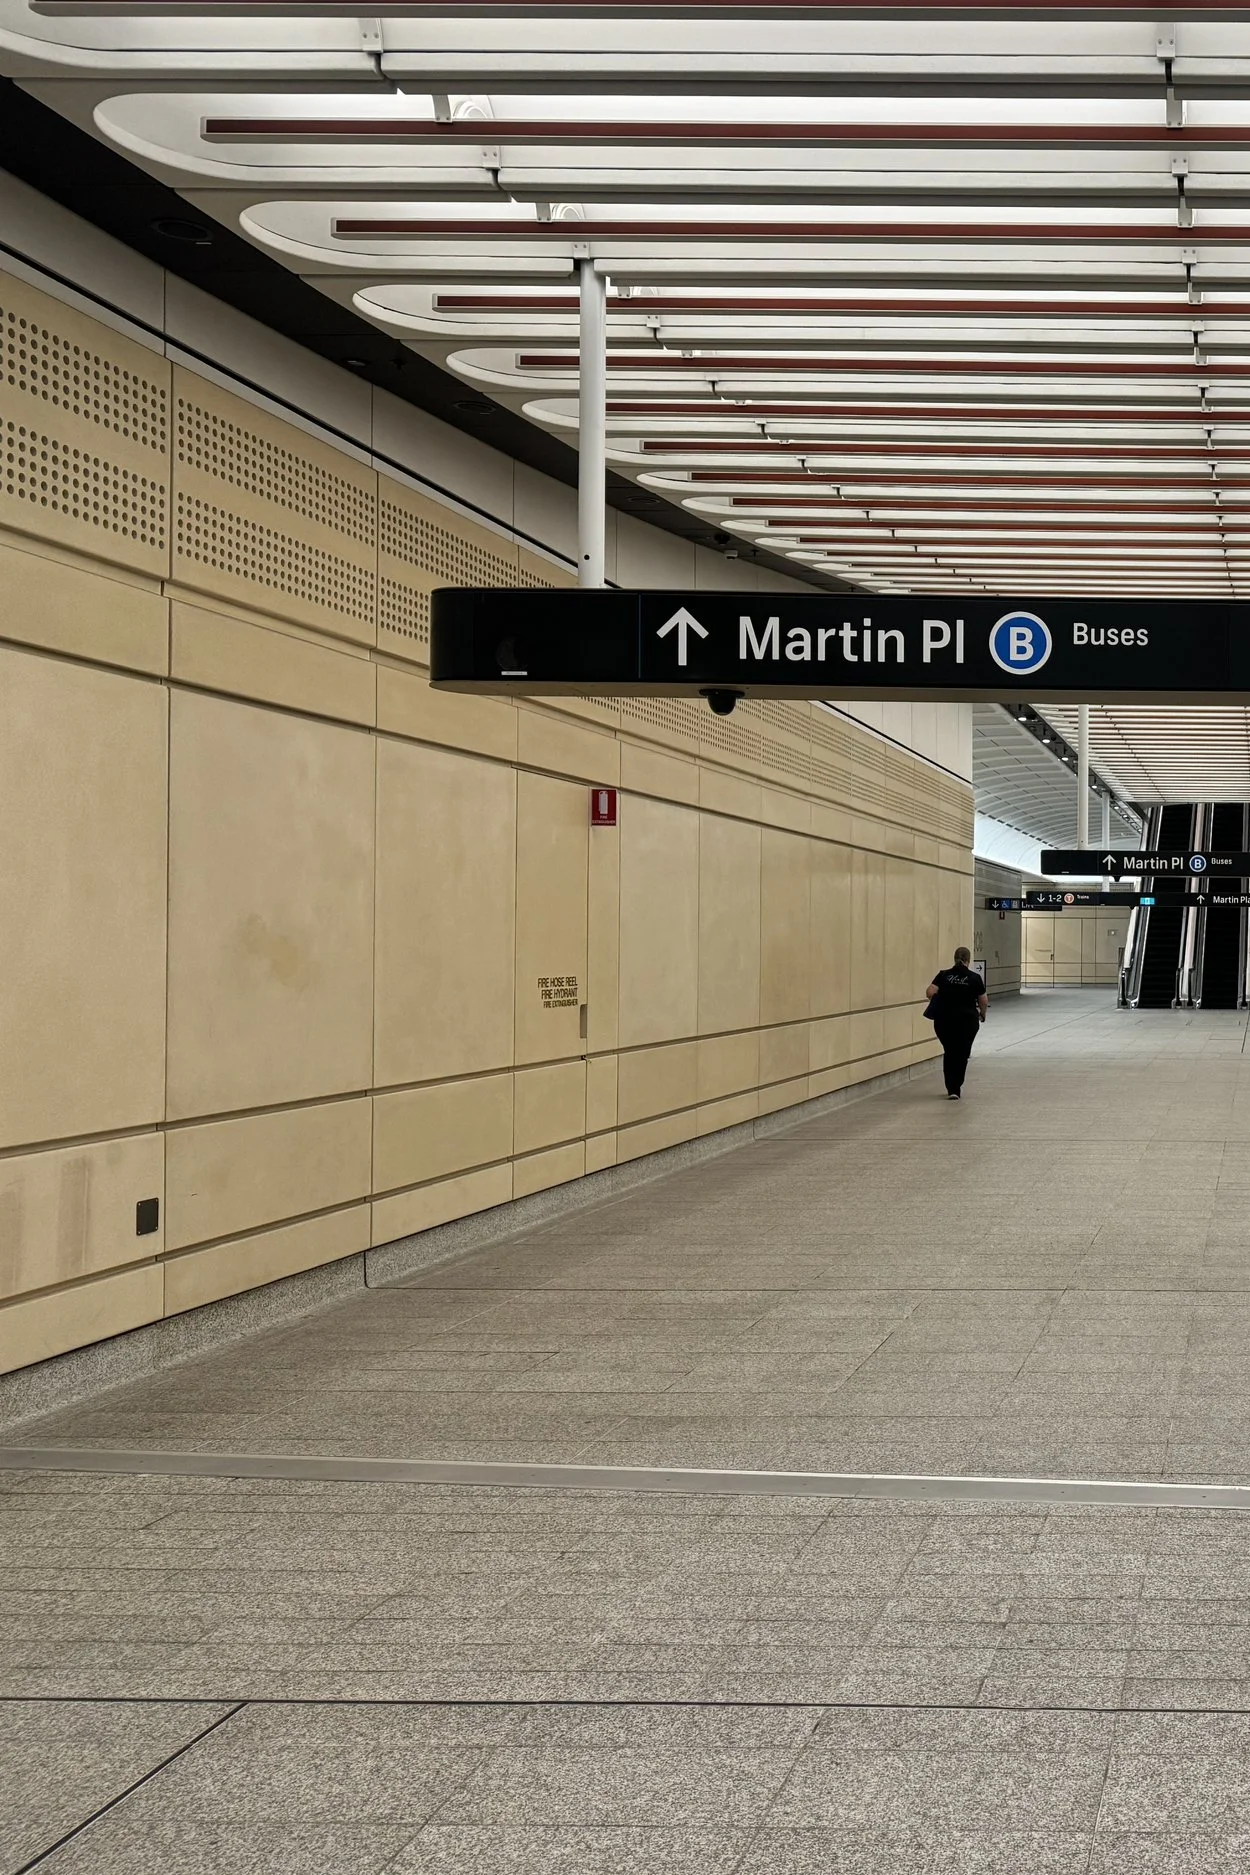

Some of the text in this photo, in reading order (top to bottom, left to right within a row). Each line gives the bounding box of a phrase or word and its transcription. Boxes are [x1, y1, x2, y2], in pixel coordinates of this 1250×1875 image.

[740, 616, 1149, 664] Martin Pl B Buses
[1123, 856, 1168, 869] Martin
[1171, 857, 1184, 870] Pl
[1211, 857, 1233, 865] Buses
[1213, 896, 1239, 904] Martin
[537, 976, 578, 988] FIRE HOSE REEL
[541, 987, 578, 999] FIRE HYDRANT
[543, 999, 578, 1008] FIRE EXTINGUISHER
